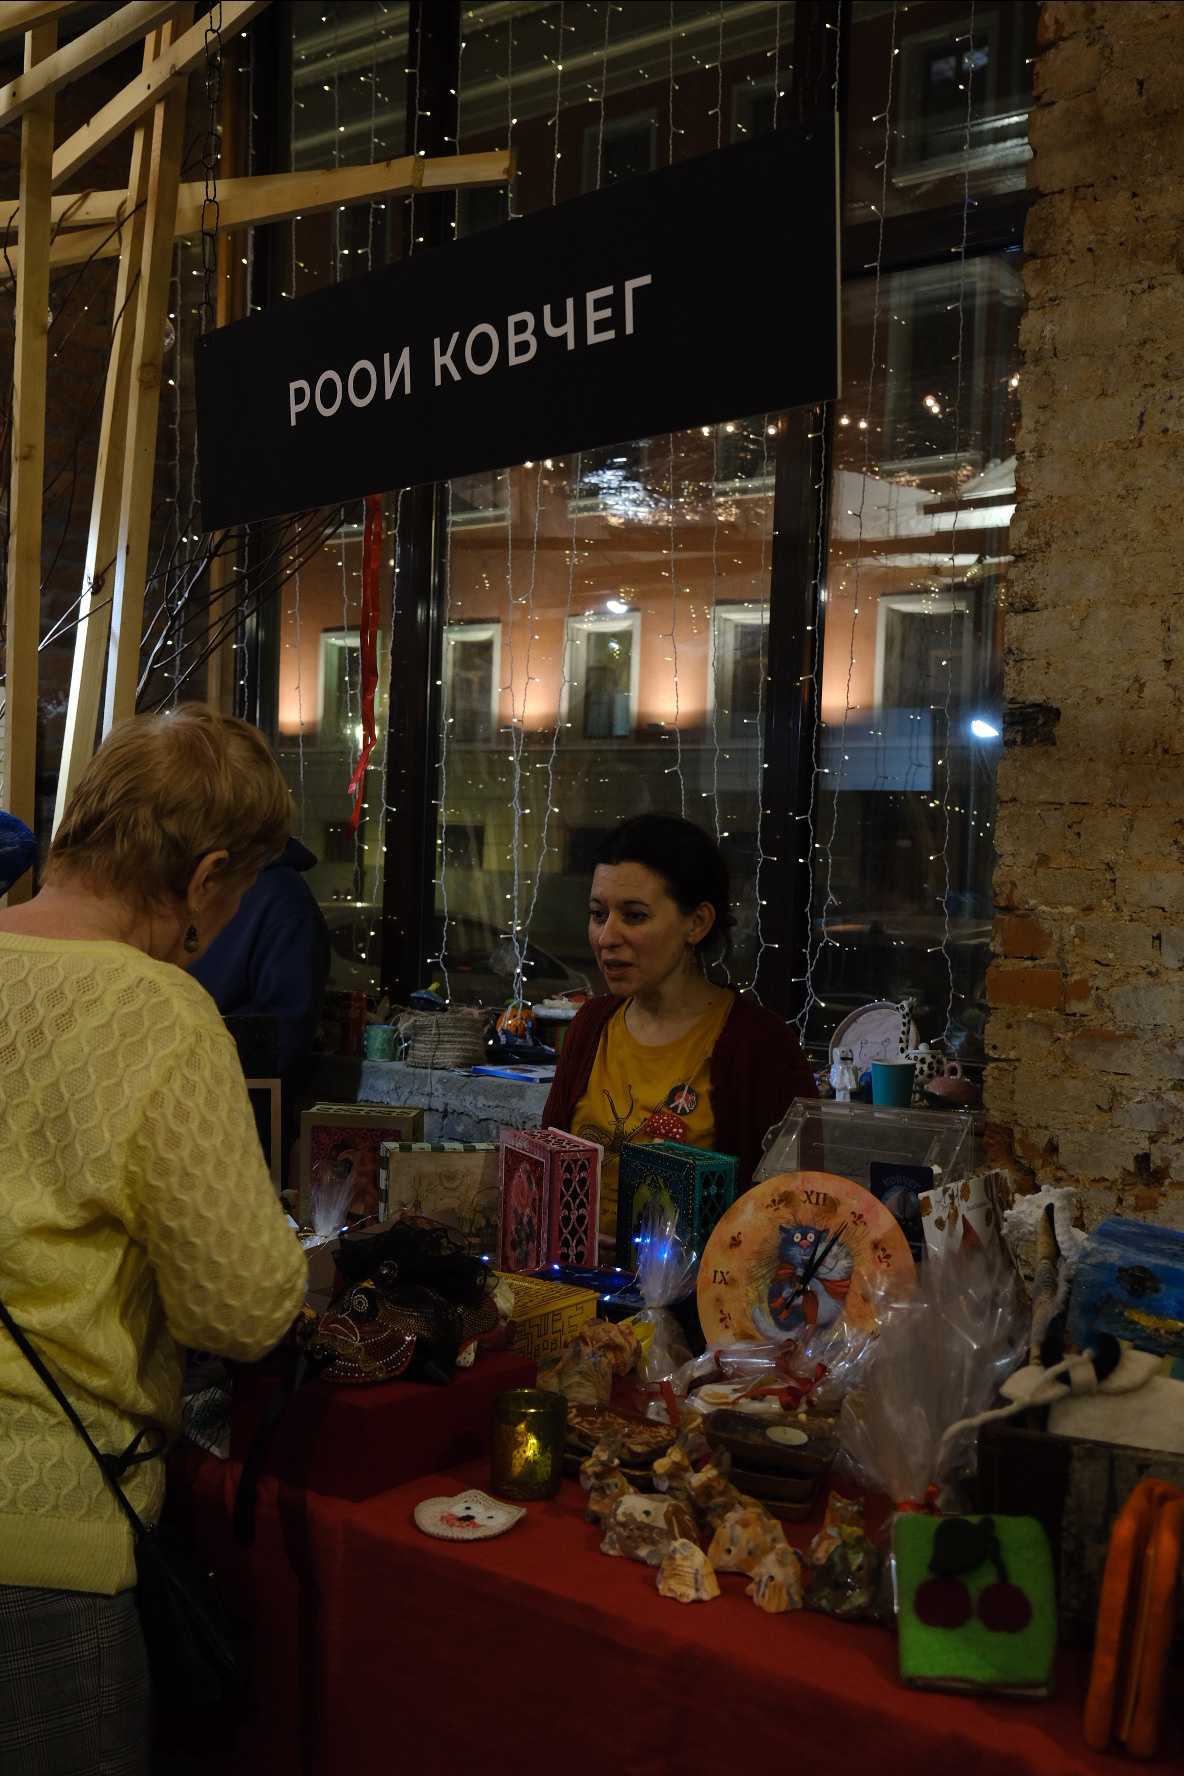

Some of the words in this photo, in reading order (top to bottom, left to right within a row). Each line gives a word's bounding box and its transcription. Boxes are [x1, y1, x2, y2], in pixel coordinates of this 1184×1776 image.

[289, 346, 412, 426] РООИ
[432, 273, 653, 386] КОВЧЕГ
[803, 1190, 828, 1207] XII
[712, 1269, 729, 1285] IX
